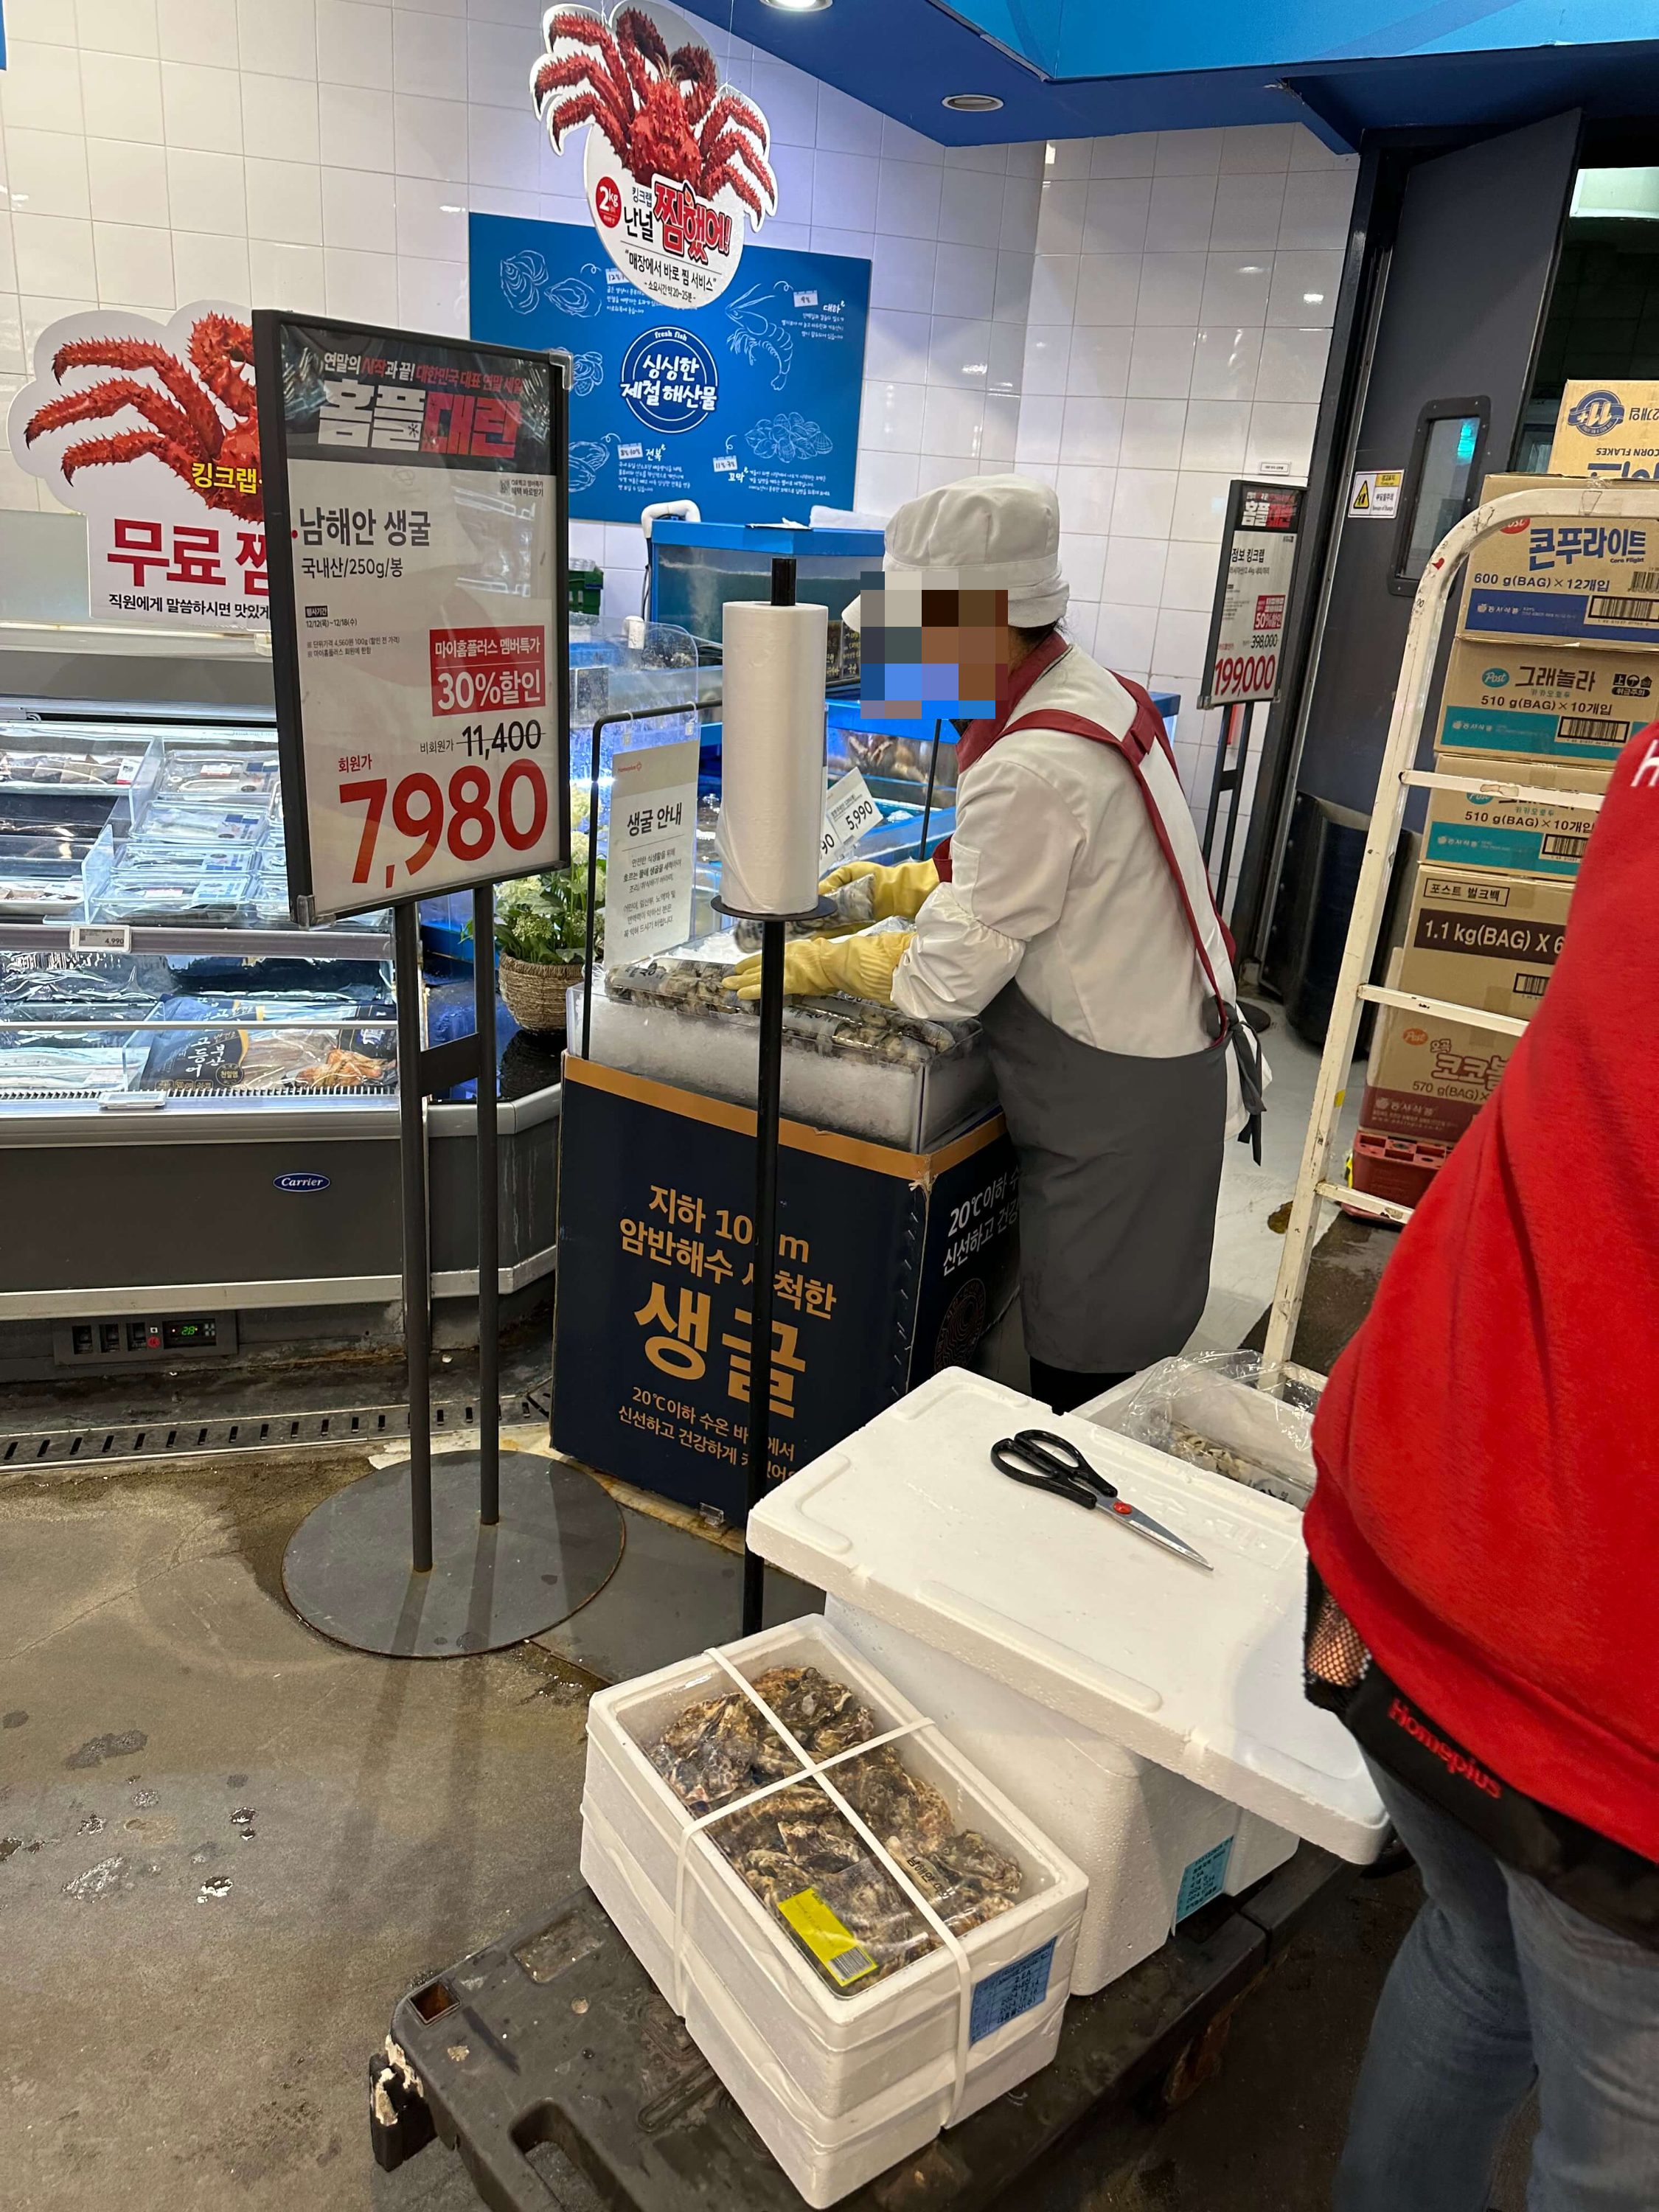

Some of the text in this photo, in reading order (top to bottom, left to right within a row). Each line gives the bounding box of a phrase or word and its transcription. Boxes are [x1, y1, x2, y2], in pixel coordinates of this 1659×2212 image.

[632, 187, 653, 208] 킹크랩
[653, 180, 732, 265] 찜했어!
[664, 263, 679, 283] 바로
[681, 268, 689, 286] 찜
[823, 303, 841, 313] 대하
[654, 330, 687, 341] fresh fish
[324, 352, 524, 394] 연말의 시작과 끝! 대한민국 대표 연말 세일
[642, 354, 700, 381] 싱싱한
[620, 380, 717, 411] 제철 해산물
[318, 378, 522, 459] 홈플대란
[645, 448, 662, 462] 전복
[1596, 448, 1631, 456] FLAKES
[728, 472, 745, 483] 꼬막
[523, 487, 543, 497] 바로받기
[299, 507, 431, 546] 남해안 생굴
[108, 518, 226, 588] 무료
[1231, 548, 1265, 563] 점보 킹크랩
[1528, 526, 1646, 571] 콘푸라이트
[301, 557, 404, 579] 국내산/250g/봉
[1474, 573, 1499, 585] 600
[1567, 578, 1610, 593] 12개입
[108, 594, 163, 613] 직원에게
[166, 598, 232, 619] 말씀하시면
[313, 647, 344, 657] 마이홈플러스
[435, 636, 540, 658] 마이홈플러스 멤버특가
[1251, 634, 1278, 649] 398,000
[1214, 655, 1276, 697] 199,000
[1484, 671, 1506, 684] Post
[1514, 666, 1596, 692] 그래놀라
[437, 669, 540, 710] 30%할인
[1481, 695, 1505, 706] 510
[1571, 702, 1613, 716] 10개입
[420, 720, 541, 760] 비회원가 11,400
[338, 754, 372, 773] 회원가
[338, 758, 548, 888] 7,980
[627, 802, 682, 837] 생굴 안내
[845, 800, 873, 831] 5,990
[1464, 810, 1489, 823] 510
[1430, 884, 1500, 902] 포스트 벌크백
[1425, 919, 1449, 940] 1.1
[1454, 923, 1531, 951] kg(BAG)
[1404, 1032, 1426, 1043] Post
[1430, 1038, 1452, 1054] 오곡
[186, 1036, 226, 1078] 고등어 부산
[1413, 1080, 1433, 1092] 570
[281, 1177, 324, 1186] Carrier
[649, 1185, 810, 1264] 지하 10m
[619, 1218, 734, 1285] 암반해수
[943, 1217, 995, 1277] 신선하고
[619, 1405, 675, 1440] 신선하고
[678, 1428, 737, 1466] 건강하게
[699, 1412, 729, 1437] 수온
[907, 1856, 936, 1883] 남해안
